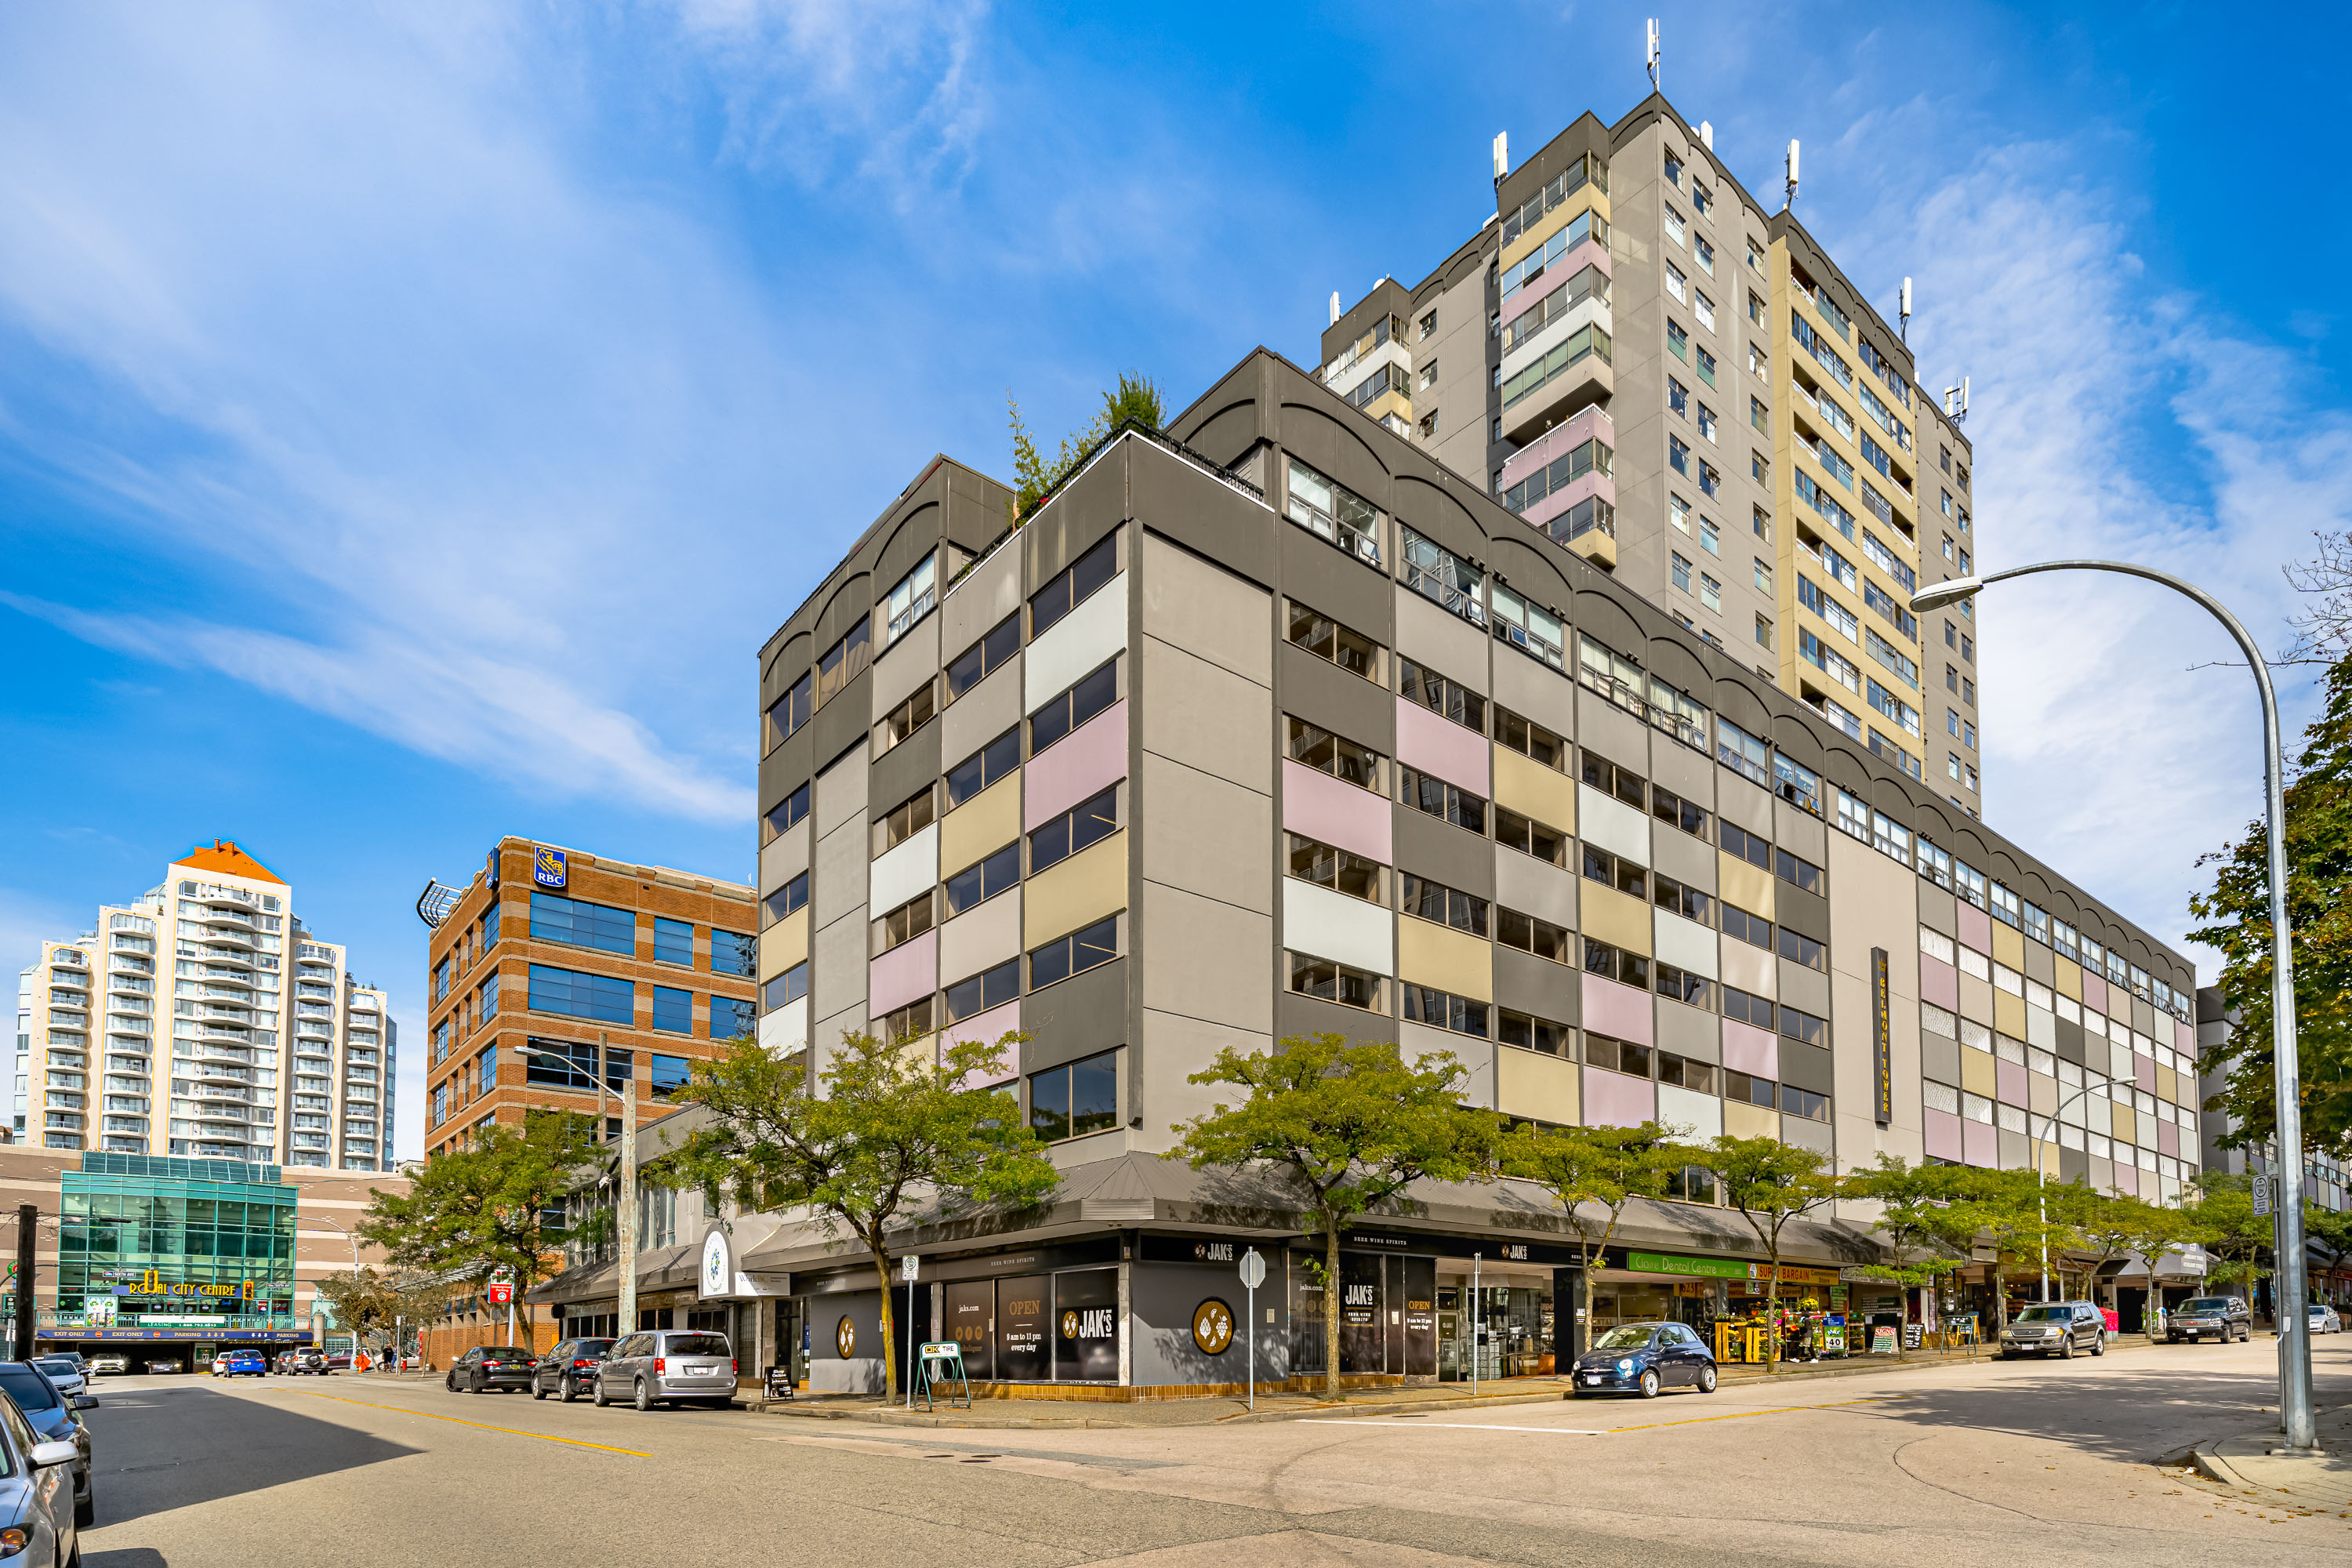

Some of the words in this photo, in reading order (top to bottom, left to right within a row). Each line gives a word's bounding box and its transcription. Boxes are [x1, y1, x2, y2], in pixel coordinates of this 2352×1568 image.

[538, 872, 562, 884] RBC
[1207, 1243, 1233, 1261] JAK'S
[1510, 1244, 1527, 1260] JAK'S
[1635, 1256, 1660, 1270] Claire
[1662, 1258, 1690, 1272] Dental
[1691, 1260, 1716, 1275] Centre
[1782, 1269, 1809, 1280] BARGAIN
[129, 1283, 169, 1294] ROAL
[172, 1283, 197, 1295] CITY
[199, 1284, 235, 1296] CENTRE
[1345, 1284, 1373, 1305] JAK'S
[958, 1304, 979, 1313] jaks.com
[1009, 1300, 1040, 1316] OPEN
[1408, 1301, 1431, 1310] OPEN
[1079, 1309, 1112, 1338] JAK'S
[1026, 1344, 1037, 1352] day
